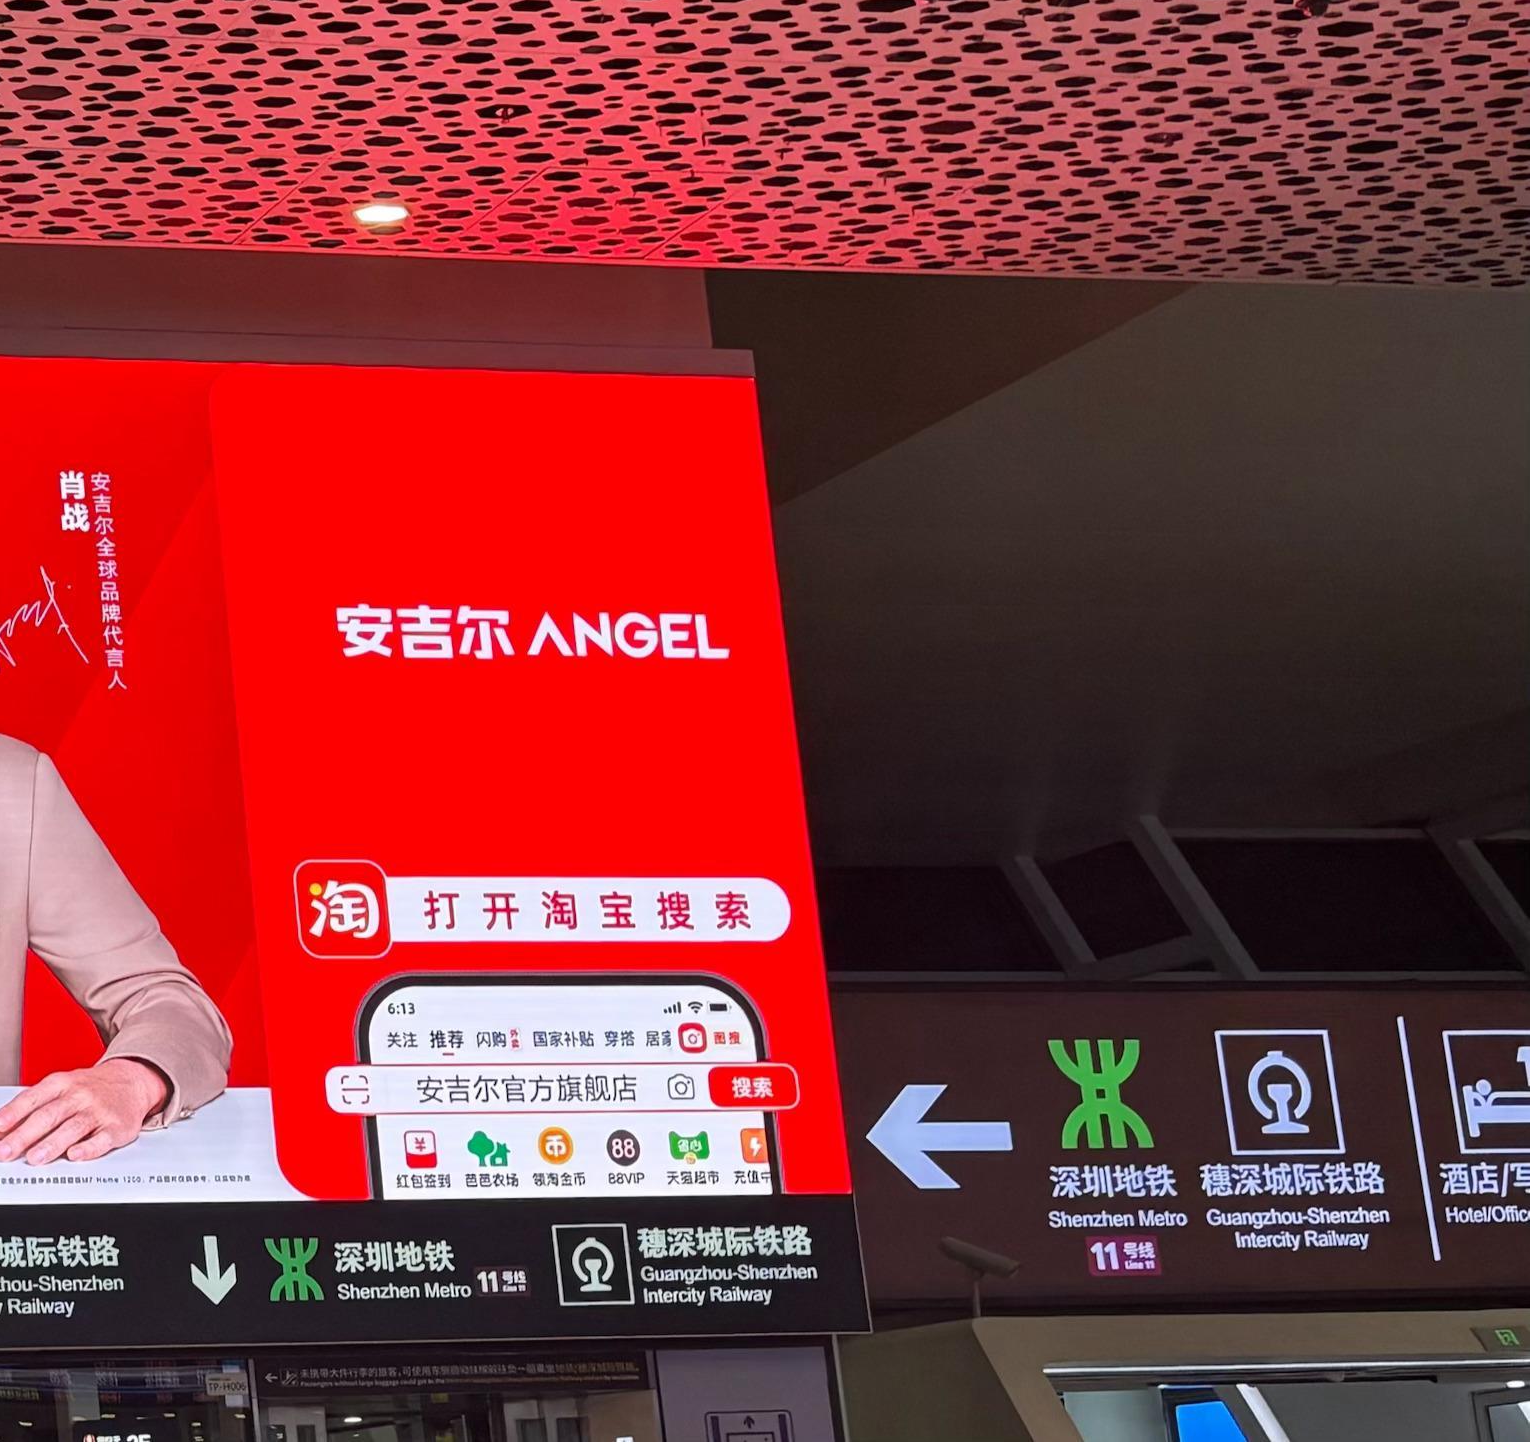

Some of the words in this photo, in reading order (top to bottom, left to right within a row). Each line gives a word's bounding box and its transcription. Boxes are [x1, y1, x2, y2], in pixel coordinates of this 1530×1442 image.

[59, 469, 90, 533] 肖战
[90, 471, 128, 690] 安吉尔全球品牌代言人
[334, 602, 516, 660] 安吉尔
[526, 610, 731, 660] ANGEL
[308, 879, 382, 940] 淘
[423, 890, 753, 932] 打开淘宝搜索
[387, 1002, 416, 1016] 6:13
[386, 1031, 419, 1048] 关注
[428, 1030, 465, 1049] 推荐
[475, 1030, 507, 1048] 闪购
[532, 1030, 595, 1048] 国家补贴
[415, 1074, 639, 1105] 安吉尔官方旗舰店
[731, 1076, 774, 1100] 搜索
[611, 1137, 636, 1160] 88
[395, 1173, 452, 1190] 红包签到
[464, 1171, 520, 1188] 芭芭农场
[532, 1171, 587, 1187] 领淘金币
[607, 1171, 646, 1186] 88VIP
[1048, 1164, 1178, 1199] 深圳地铁
[1199, 1162, 1386, 1197] 穗深城际铁路
[1048, 1209, 1136, 1229] Shenzhen
[1137, 1208, 1189, 1227] Metro
[1206, 1205, 1391, 1227] Guangzhou-Shenzhen
[638, 1225, 813, 1258] 穗深城际铁路
[1235, 1230, 1301, 1252] Intercity
[1304, 1229, 1370, 1251] Railway
[333, 1240, 455, 1274] 深圳地铁
[1089, 1241, 1121, 1272] 11
[1122, 1240, 1157, 1261] 号线
[476, 1270, 499, 1293] 11
[640, 1263, 818, 1285] Guangzhou-Shenzhen
[337, 1281, 420, 1302] Shenzhen
[422, 1280, 472, 1300] Metro
[642, 1286, 706, 1306] Intercity
[708, 1284, 773, 1306] Railway
[7, 1295, 75, 1318] Railway
